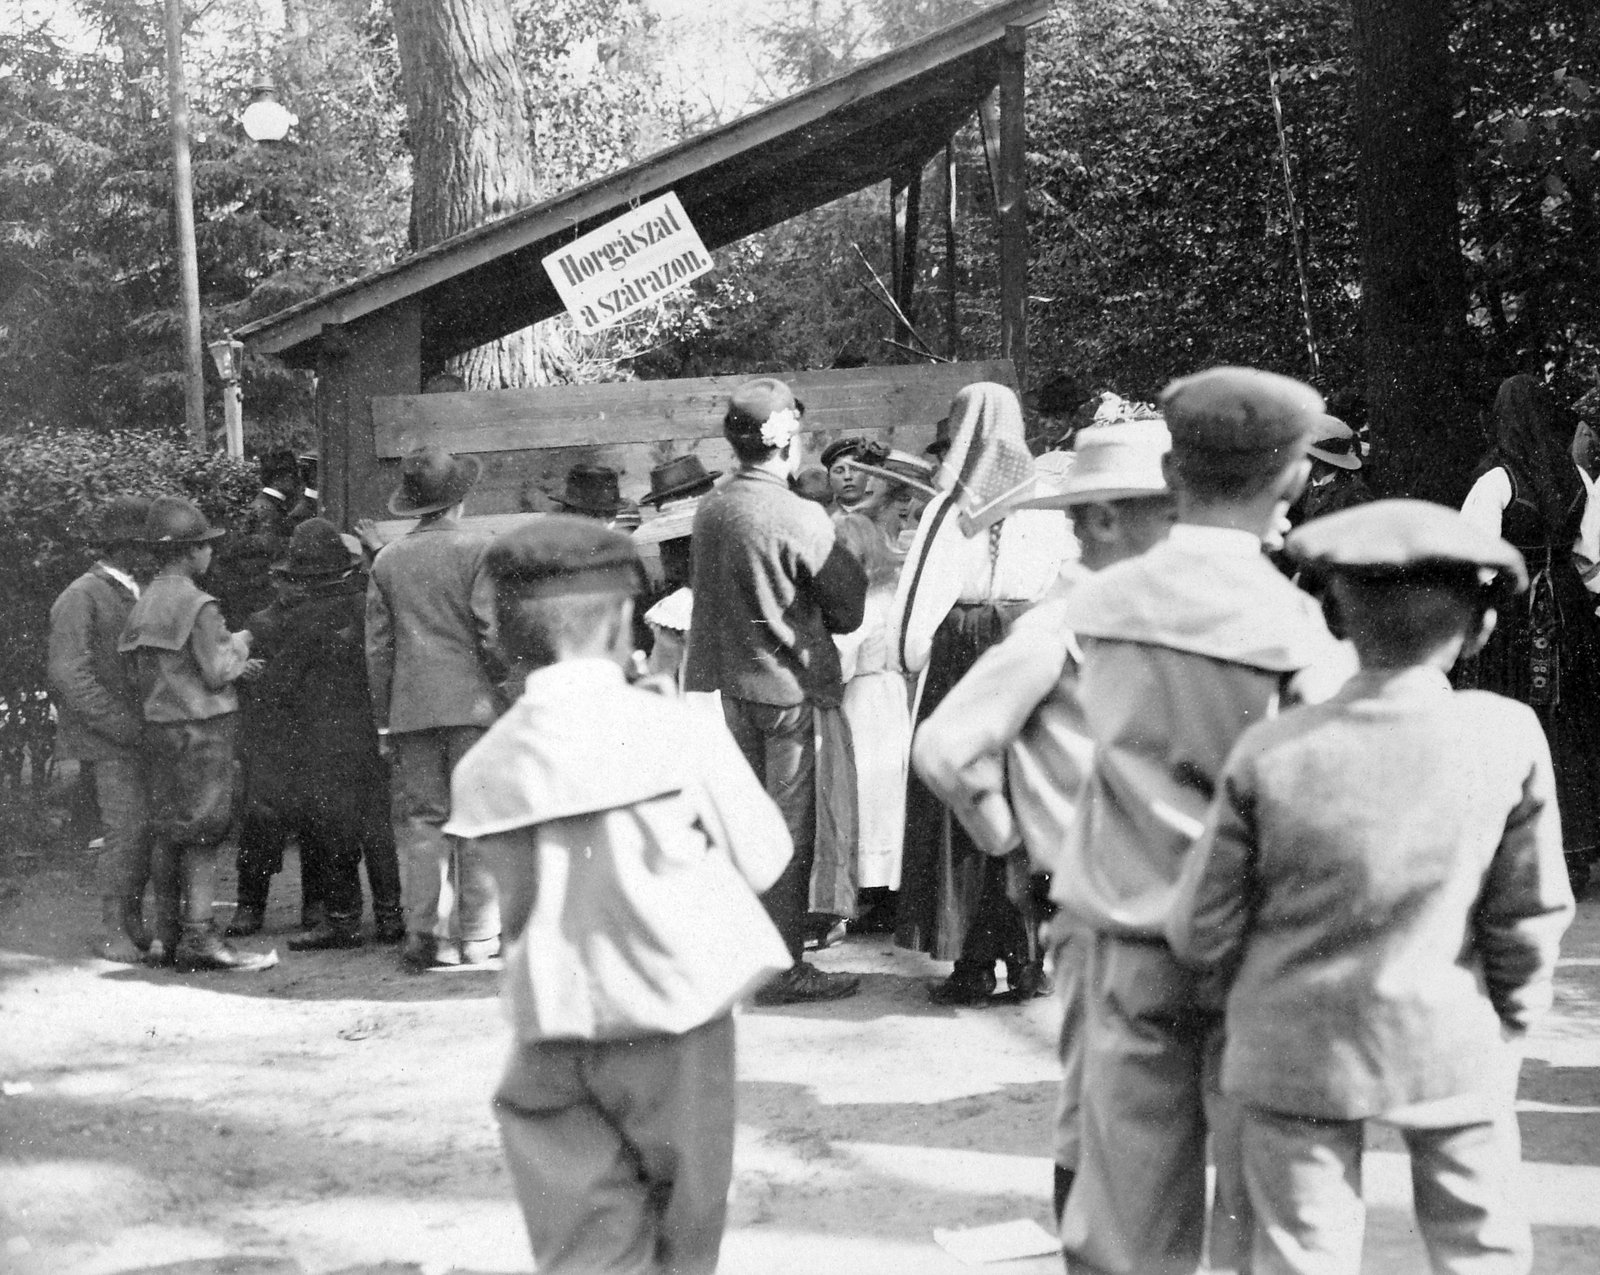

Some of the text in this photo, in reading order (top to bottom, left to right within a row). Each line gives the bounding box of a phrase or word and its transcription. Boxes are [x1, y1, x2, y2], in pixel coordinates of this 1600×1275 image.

[558, 203, 681, 287] Horgászat
[580, 250, 707, 328] a szárazon.
